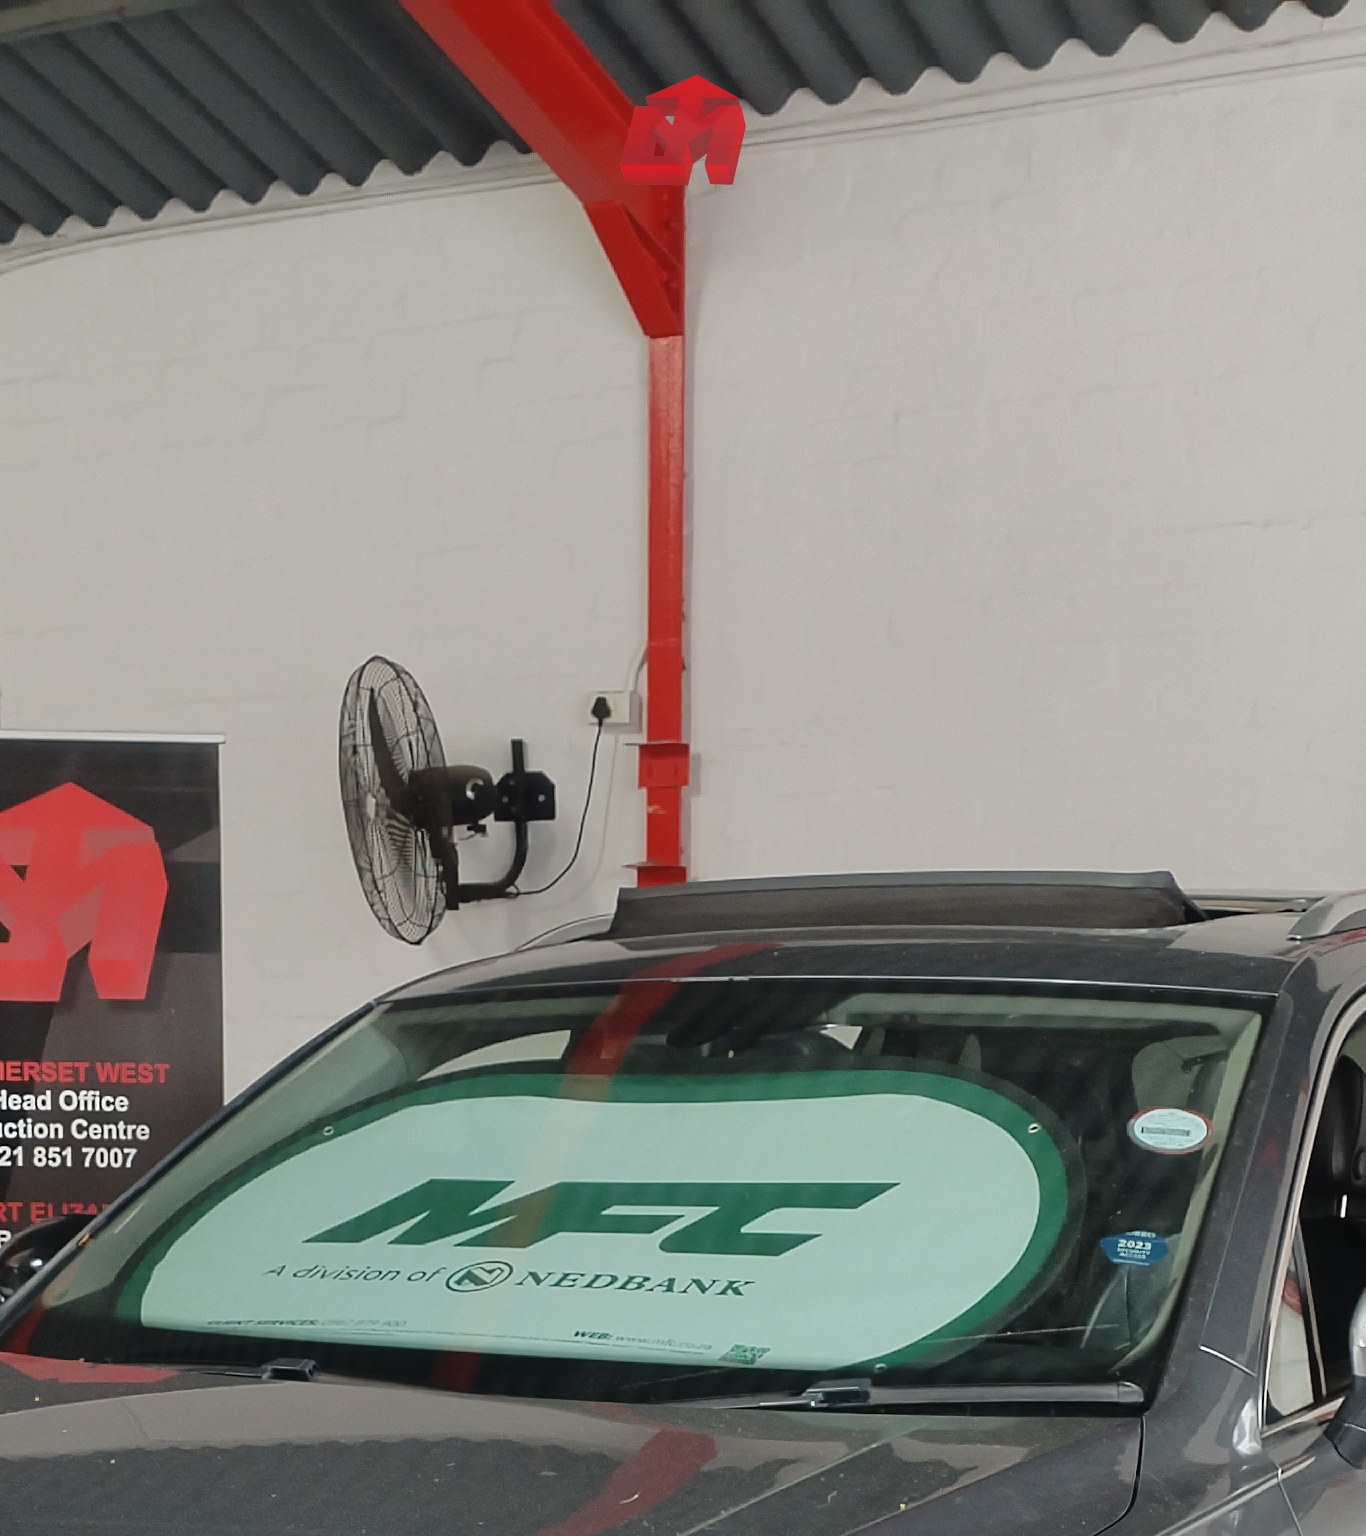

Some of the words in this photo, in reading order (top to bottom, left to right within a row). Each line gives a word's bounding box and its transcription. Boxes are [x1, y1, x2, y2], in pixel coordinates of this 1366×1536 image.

[96, 1061, 170, 1084] WEST
[58, 1089, 129, 1112] Office
[70, 1117, 150, 1142] Centre
[33, 1146, 73, 1168] 851
[81, 1147, 137, 1169] 7007
[301, 1178, 902, 1257] MFC
[263, 1264, 286, 1277] A
[292, 1264, 401, 1282] division
[406, 1267, 447, 1283] of
[515, 1271, 755, 1296] NEDBANK
